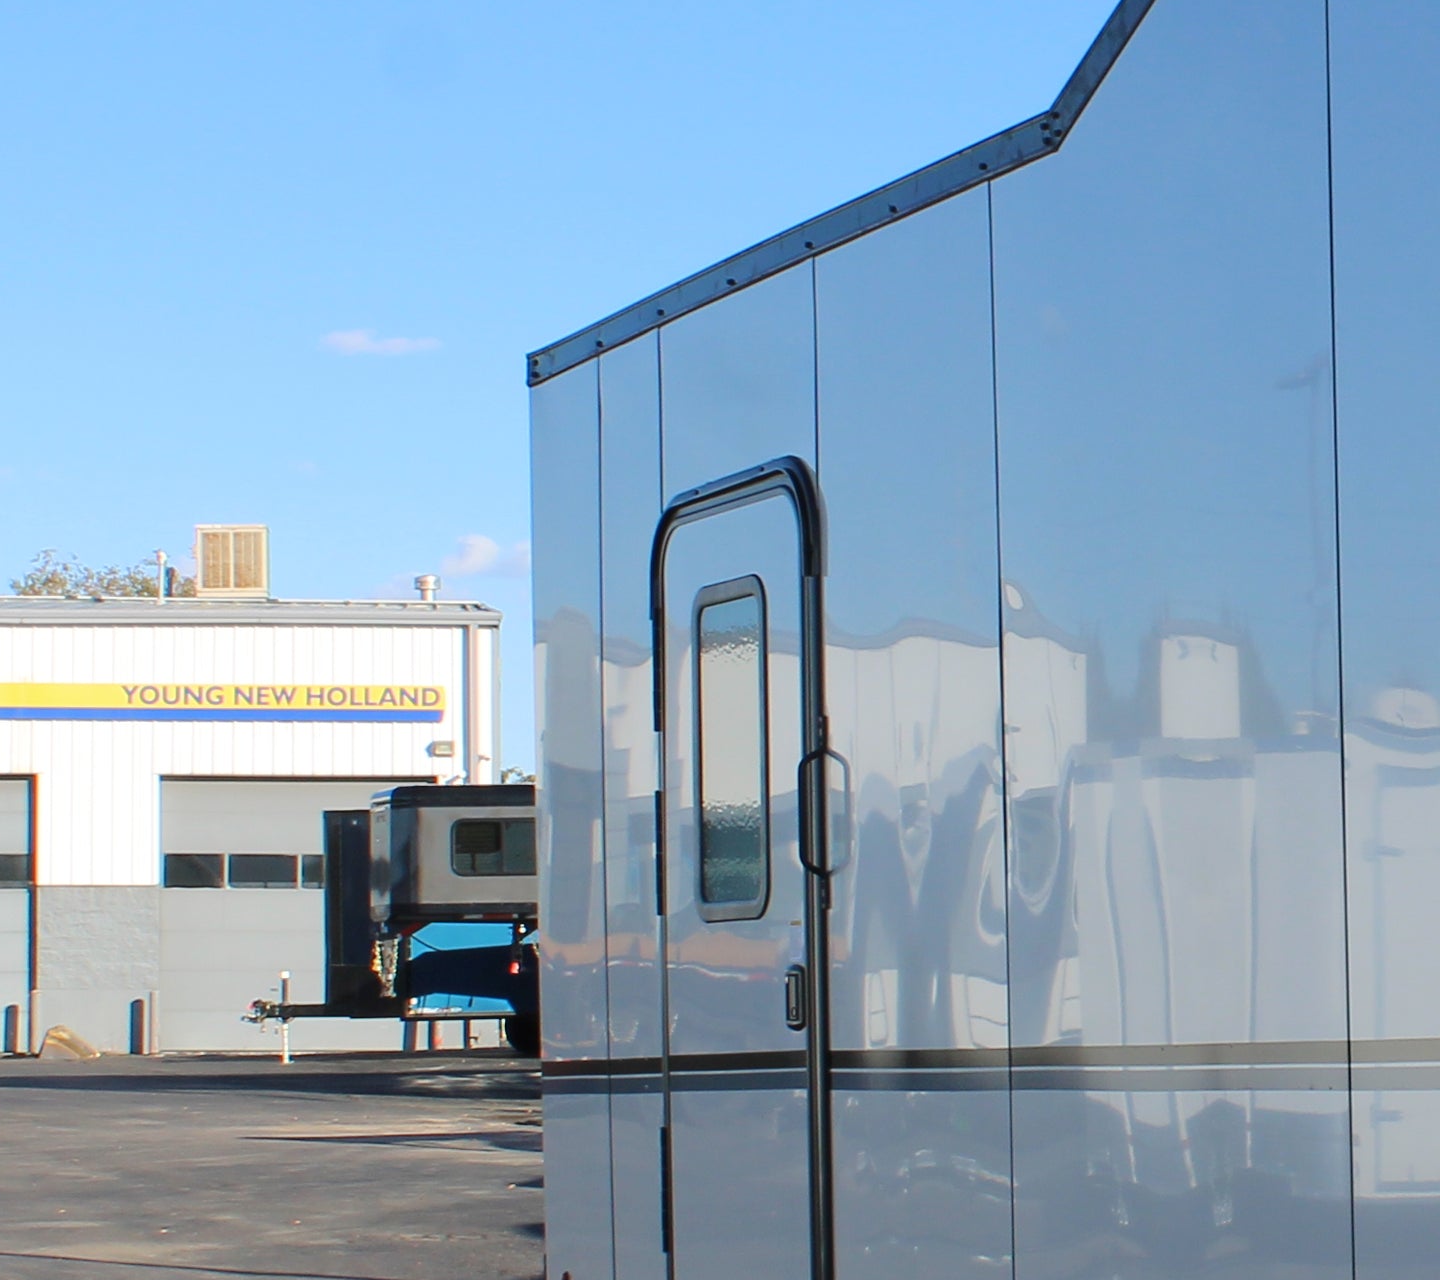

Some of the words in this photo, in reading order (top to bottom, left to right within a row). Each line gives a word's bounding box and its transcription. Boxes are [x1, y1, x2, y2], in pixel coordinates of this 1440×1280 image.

[121, 685, 224, 706] YOUNG
[233, 685, 297, 707] NEW
[305, 686, 441, 707] HOLLAND
